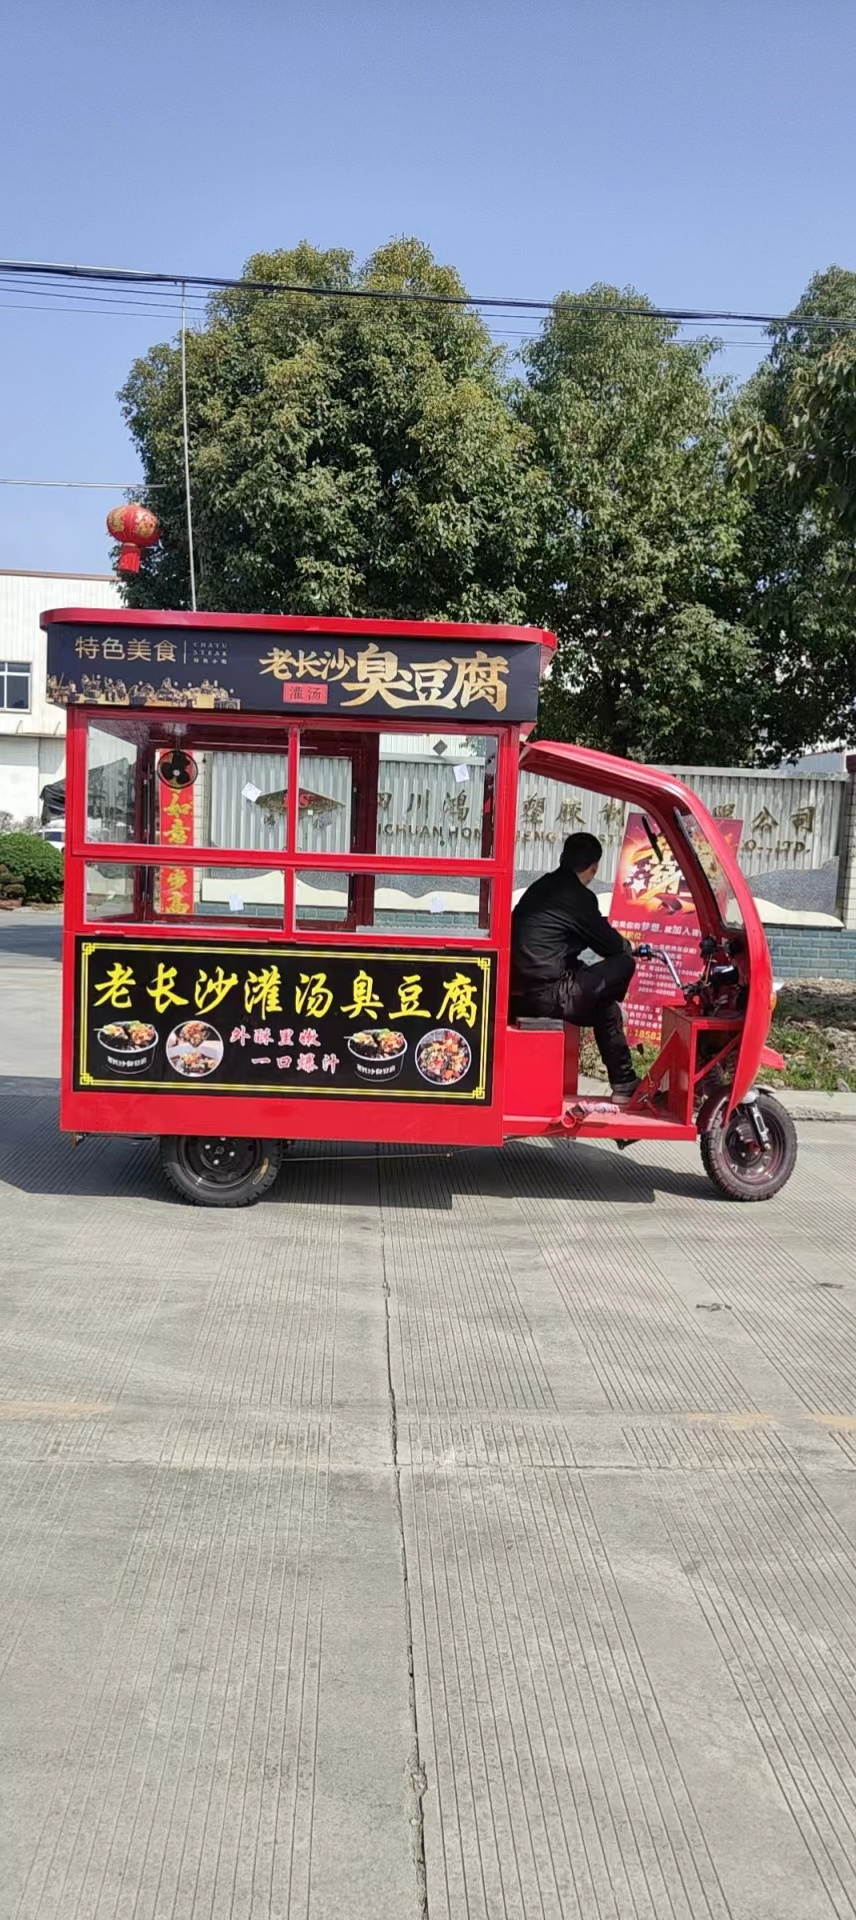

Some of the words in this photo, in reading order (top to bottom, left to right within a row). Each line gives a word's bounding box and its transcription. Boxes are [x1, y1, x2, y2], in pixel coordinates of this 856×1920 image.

[75, 636, 178, 662] 特色美食
[289, 685, 321, 701] 灌汤
[378, 823, 443, 838] ICHUAN
[93, 961, 479, 1029] 老长沙灌汤臭豆腐
[229, 1024, 321, 1047] 外酥里嫩
[251, 1052, 340, 1075] 一口爆汁
